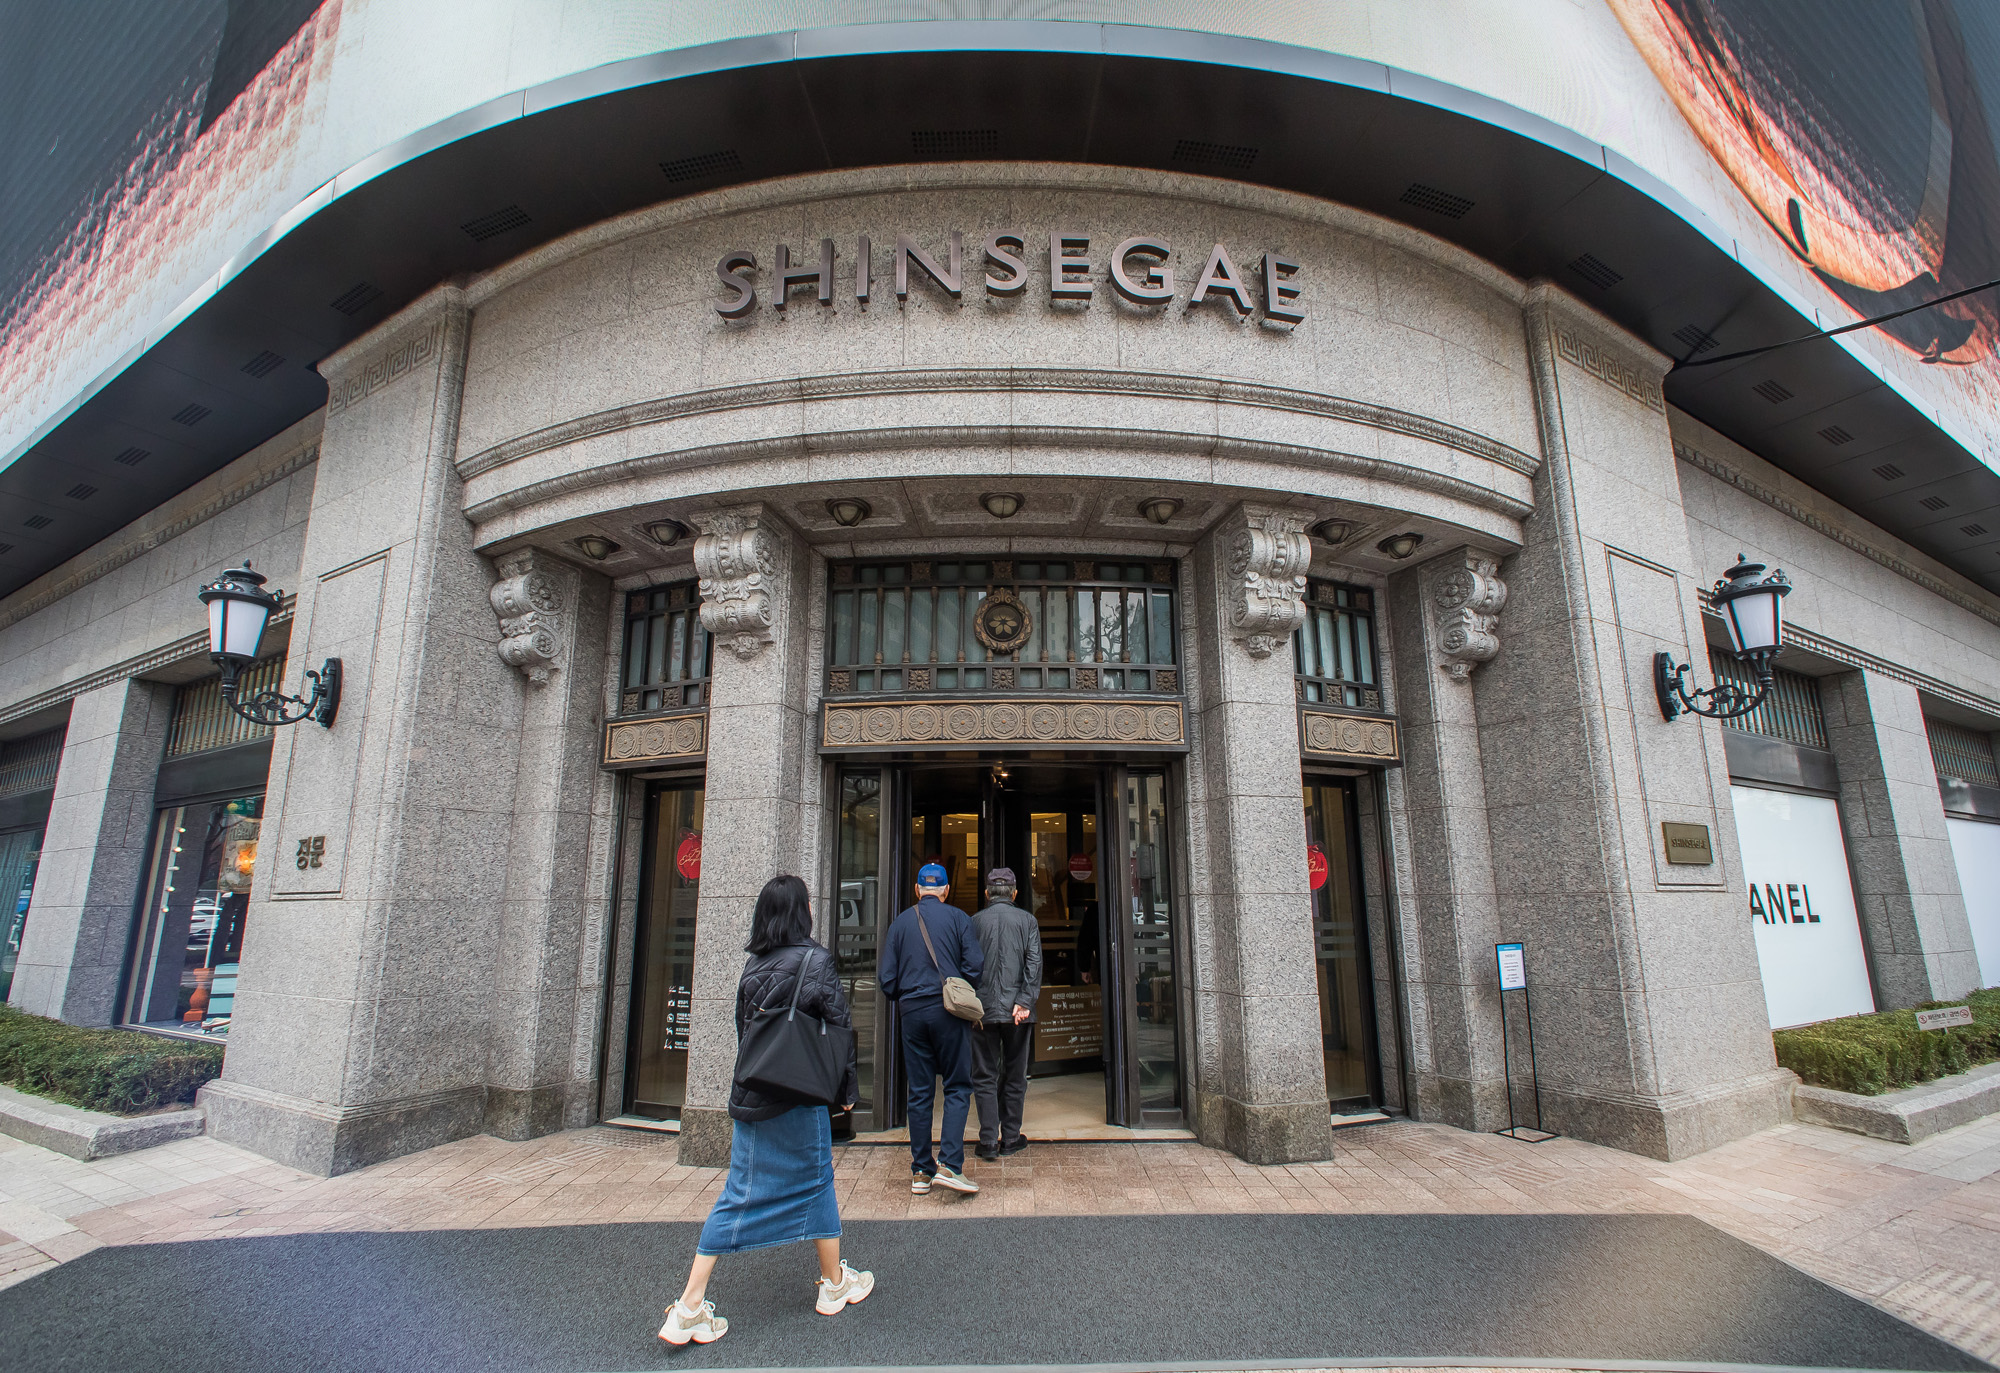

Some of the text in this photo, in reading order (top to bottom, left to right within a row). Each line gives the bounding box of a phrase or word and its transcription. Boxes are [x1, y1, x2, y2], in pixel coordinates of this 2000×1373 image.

[715, 230, 1305, 323] SHINSEGAE
[296, 836, 326, 870] 정문
[1671, 838, 1707, 850] SHINSEGAE
[1749, 883, 1820, 925] ANEL
